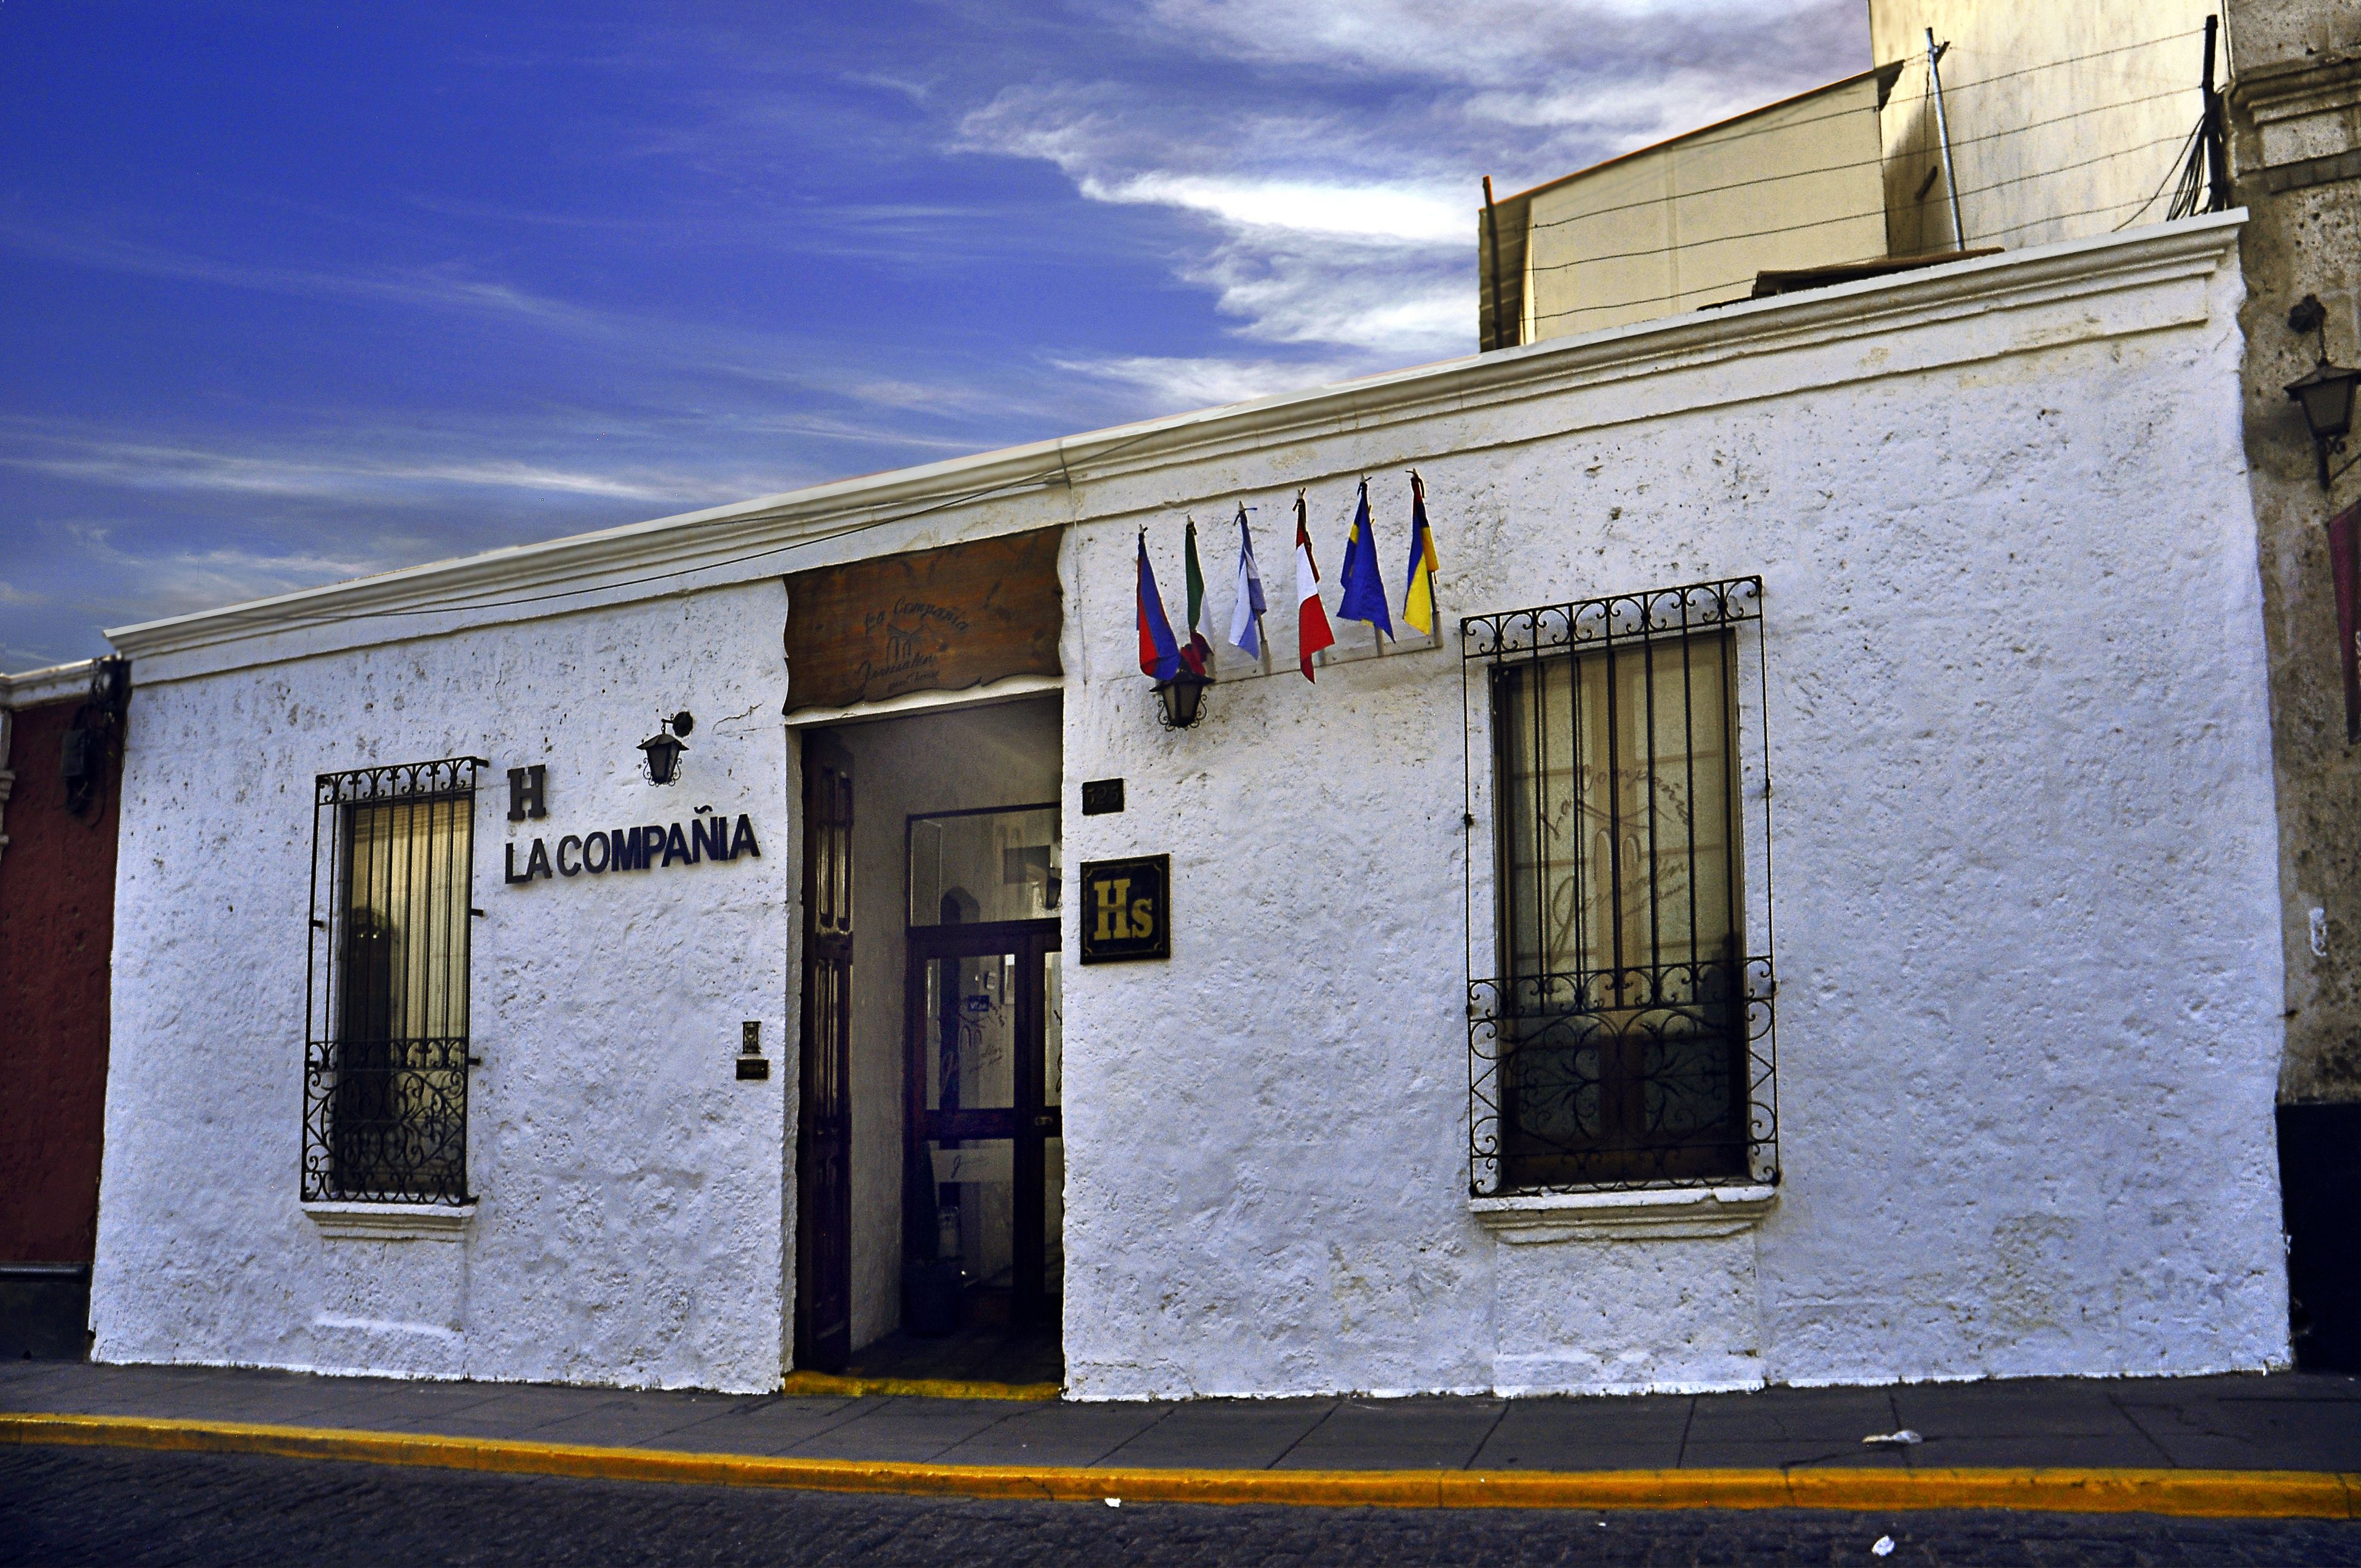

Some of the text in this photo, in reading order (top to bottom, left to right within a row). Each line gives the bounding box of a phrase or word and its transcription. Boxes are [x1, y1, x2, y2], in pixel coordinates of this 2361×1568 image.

[507, 764, 547, 821] H
[505, 805, 761, 884] LA COMPAÑIA
[1094, 878, 1153, 941] Hs
